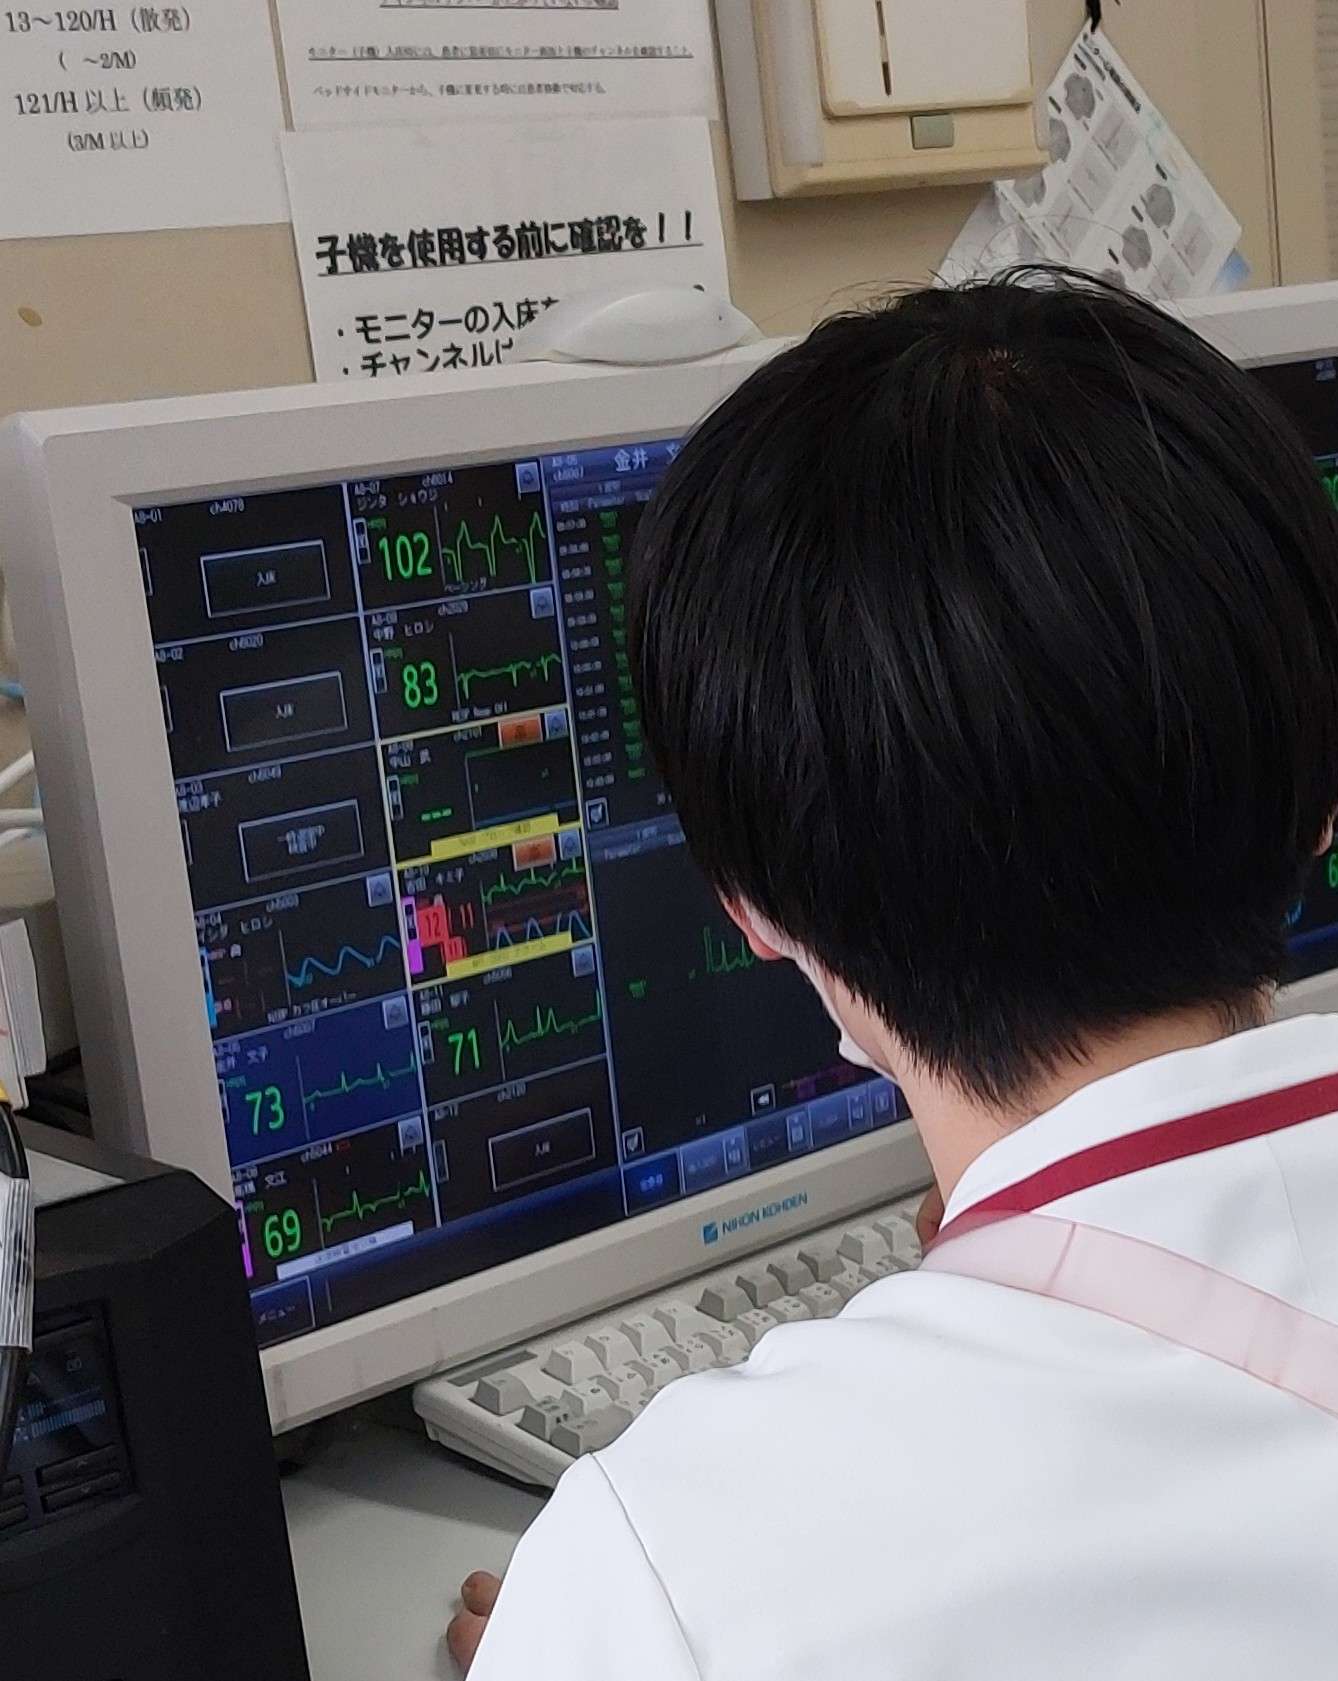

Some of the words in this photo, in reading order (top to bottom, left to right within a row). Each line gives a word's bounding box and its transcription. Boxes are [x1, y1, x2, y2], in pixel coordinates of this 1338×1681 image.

[315, 211, 693, 276] 子機を使用する前に確認を！！
[614, 448, 649, 473] 金井
[378, 530, 434, 582] 102
[402, 660, 440, 710] 83
[447, 1026, 481, 1077] 71
[245, 1085, 286, 1137] 73
[263, 1208, 301, 1258] 69
[721, 1207, 761, 1236] NIHON
[762, 1192, 809, 1223] KOHDEN
